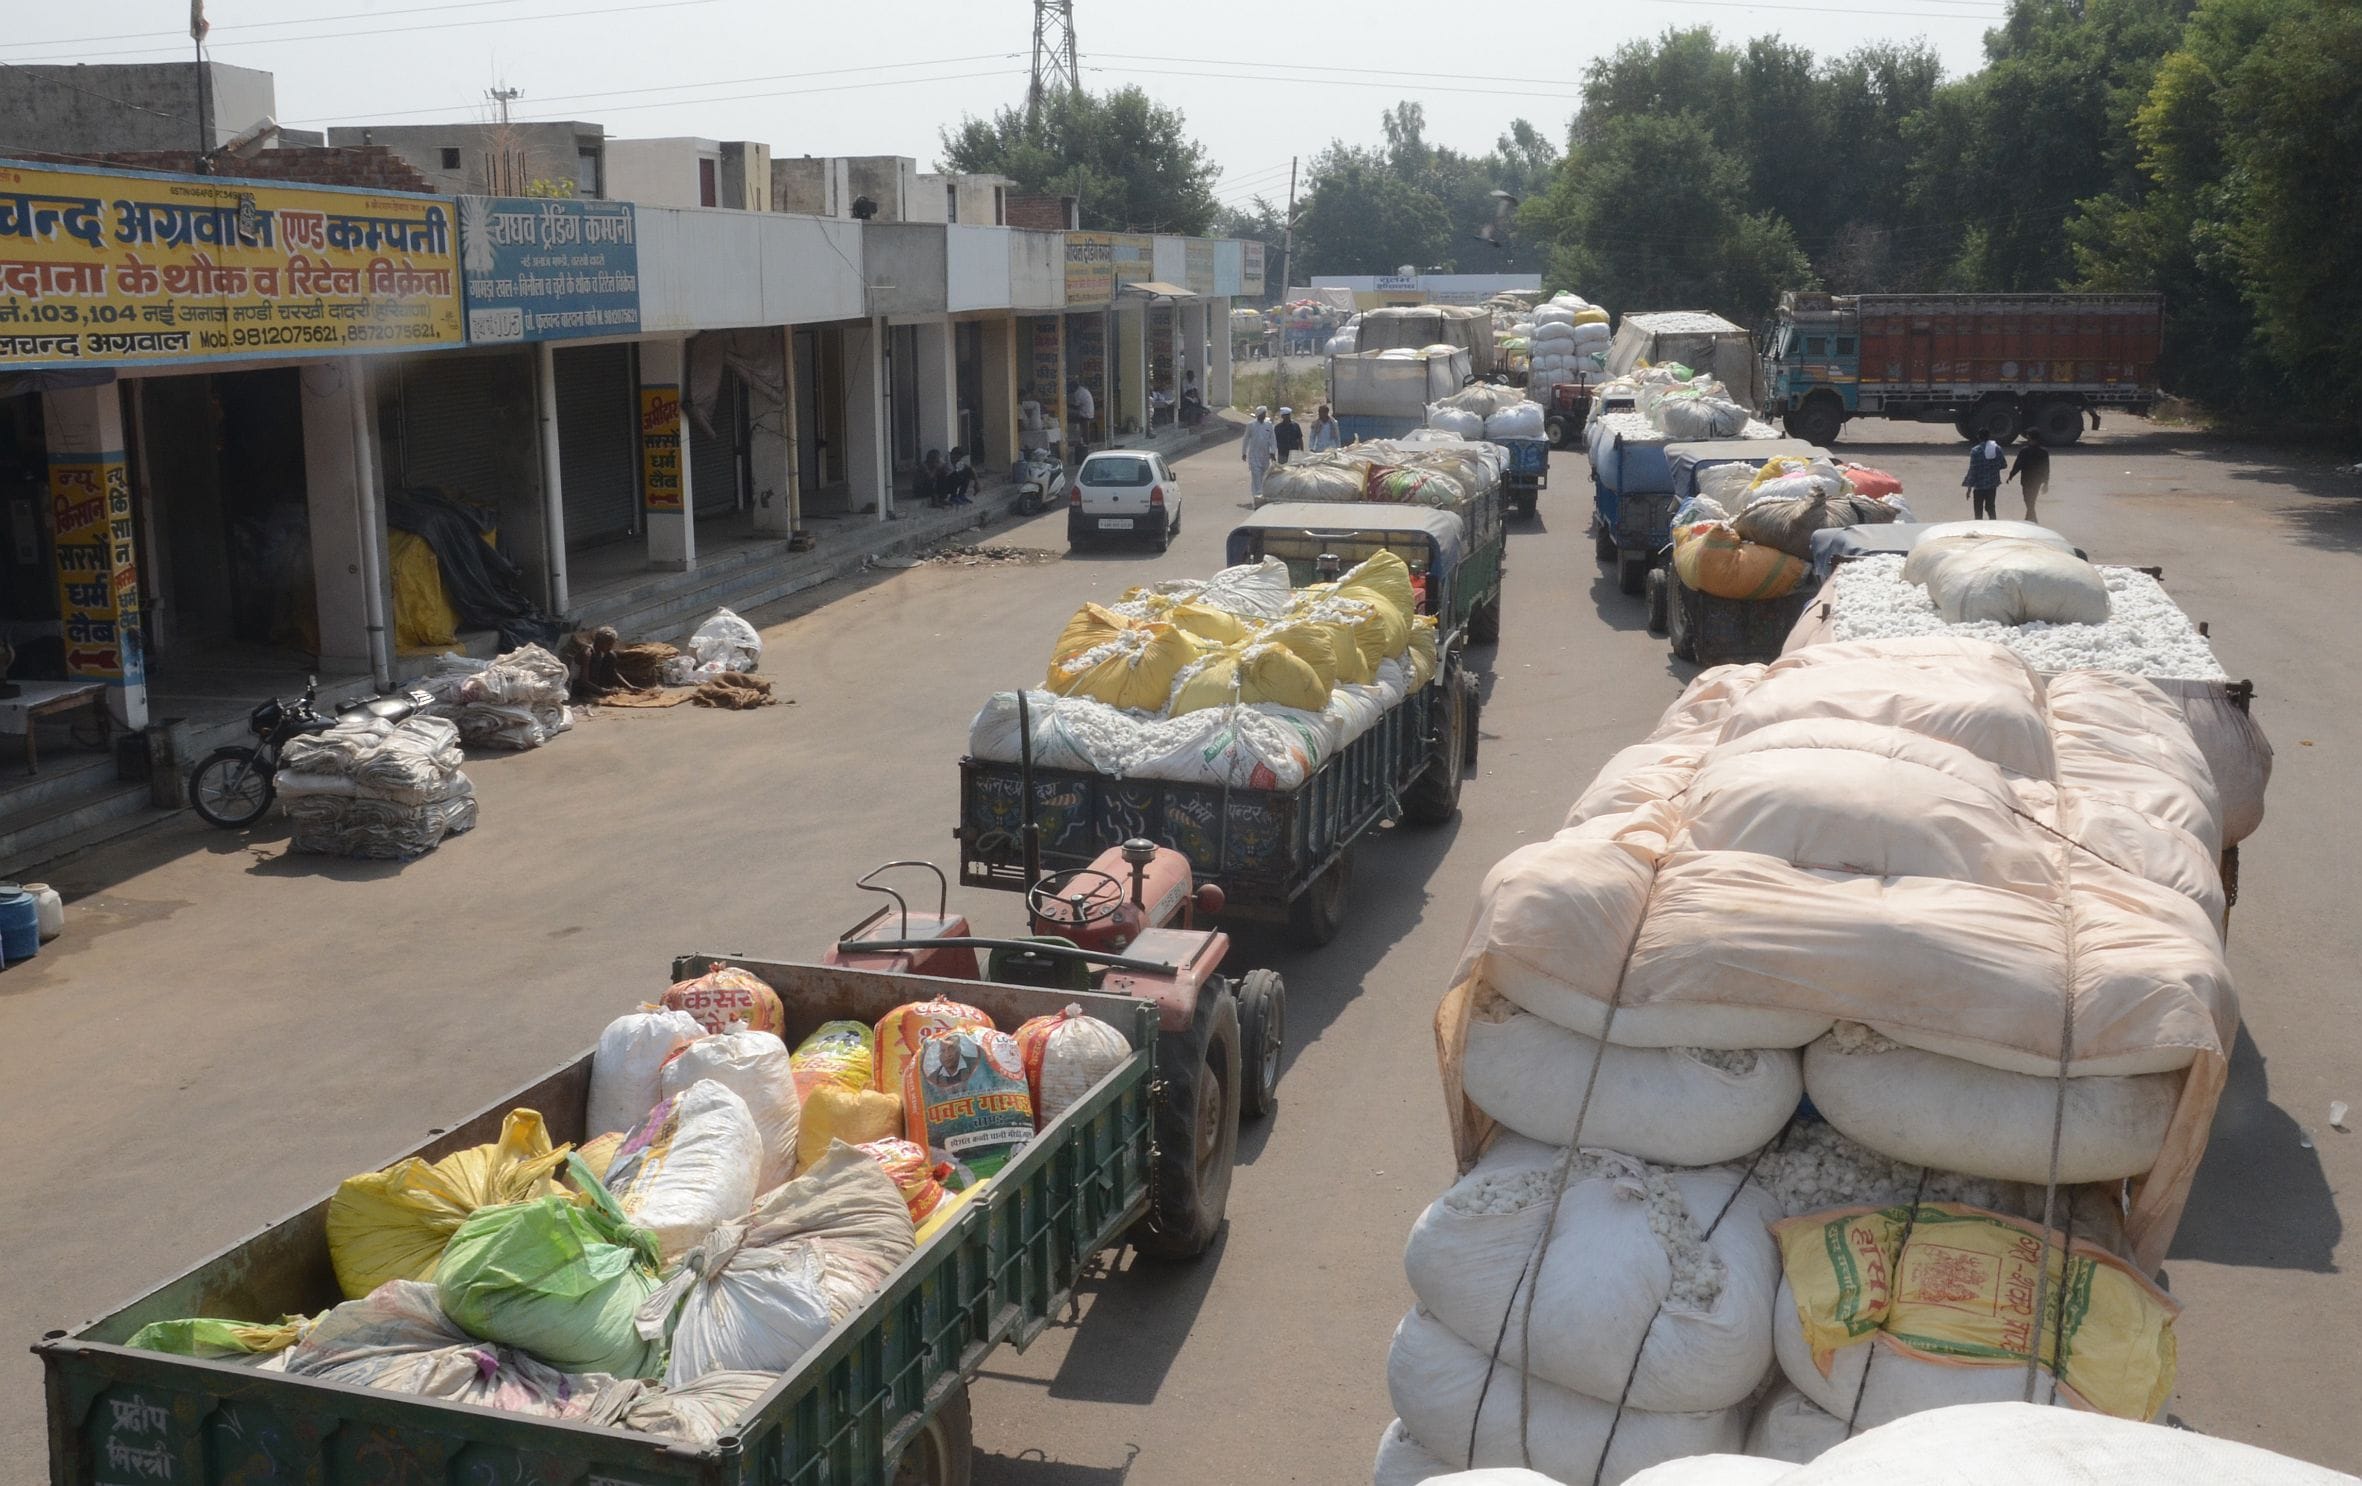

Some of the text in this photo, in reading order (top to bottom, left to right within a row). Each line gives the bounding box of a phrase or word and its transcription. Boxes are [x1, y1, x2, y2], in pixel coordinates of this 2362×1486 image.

[278, 209, 326, 255] एण्ड
[327, 206, 448, 254] कम्पनी
[493, 203, 634, 251] राघव ट्रेडिंग कम्पनी
[116, 252, 159, 296] के
[252, 266, 279, 298] व
[287, 254, 361, 297] रिटेल
[366, 257, 452, 298] विक्रेता
[142, 299, 176, 326] नई
[178, 304, 230, 323] अनाज
[233, 300, 273, 322] मण्डी
[278, 298, 324, 321] चरखी
[329, 297, 371, 321] दादरी
[87, 331, 191, 355] अग्रवाल
[643, 428, 681, 449] सरसों
[58, 469, 102, 493] न्यू
[55, 494, 106, 535] किसान
[56, 531, 112, 571] सरसों
[65, 611, 117, 643] लैब
[927, 1096, 976, 1124] पवन
[108, 1394, 171, 1436] प्रदीप
